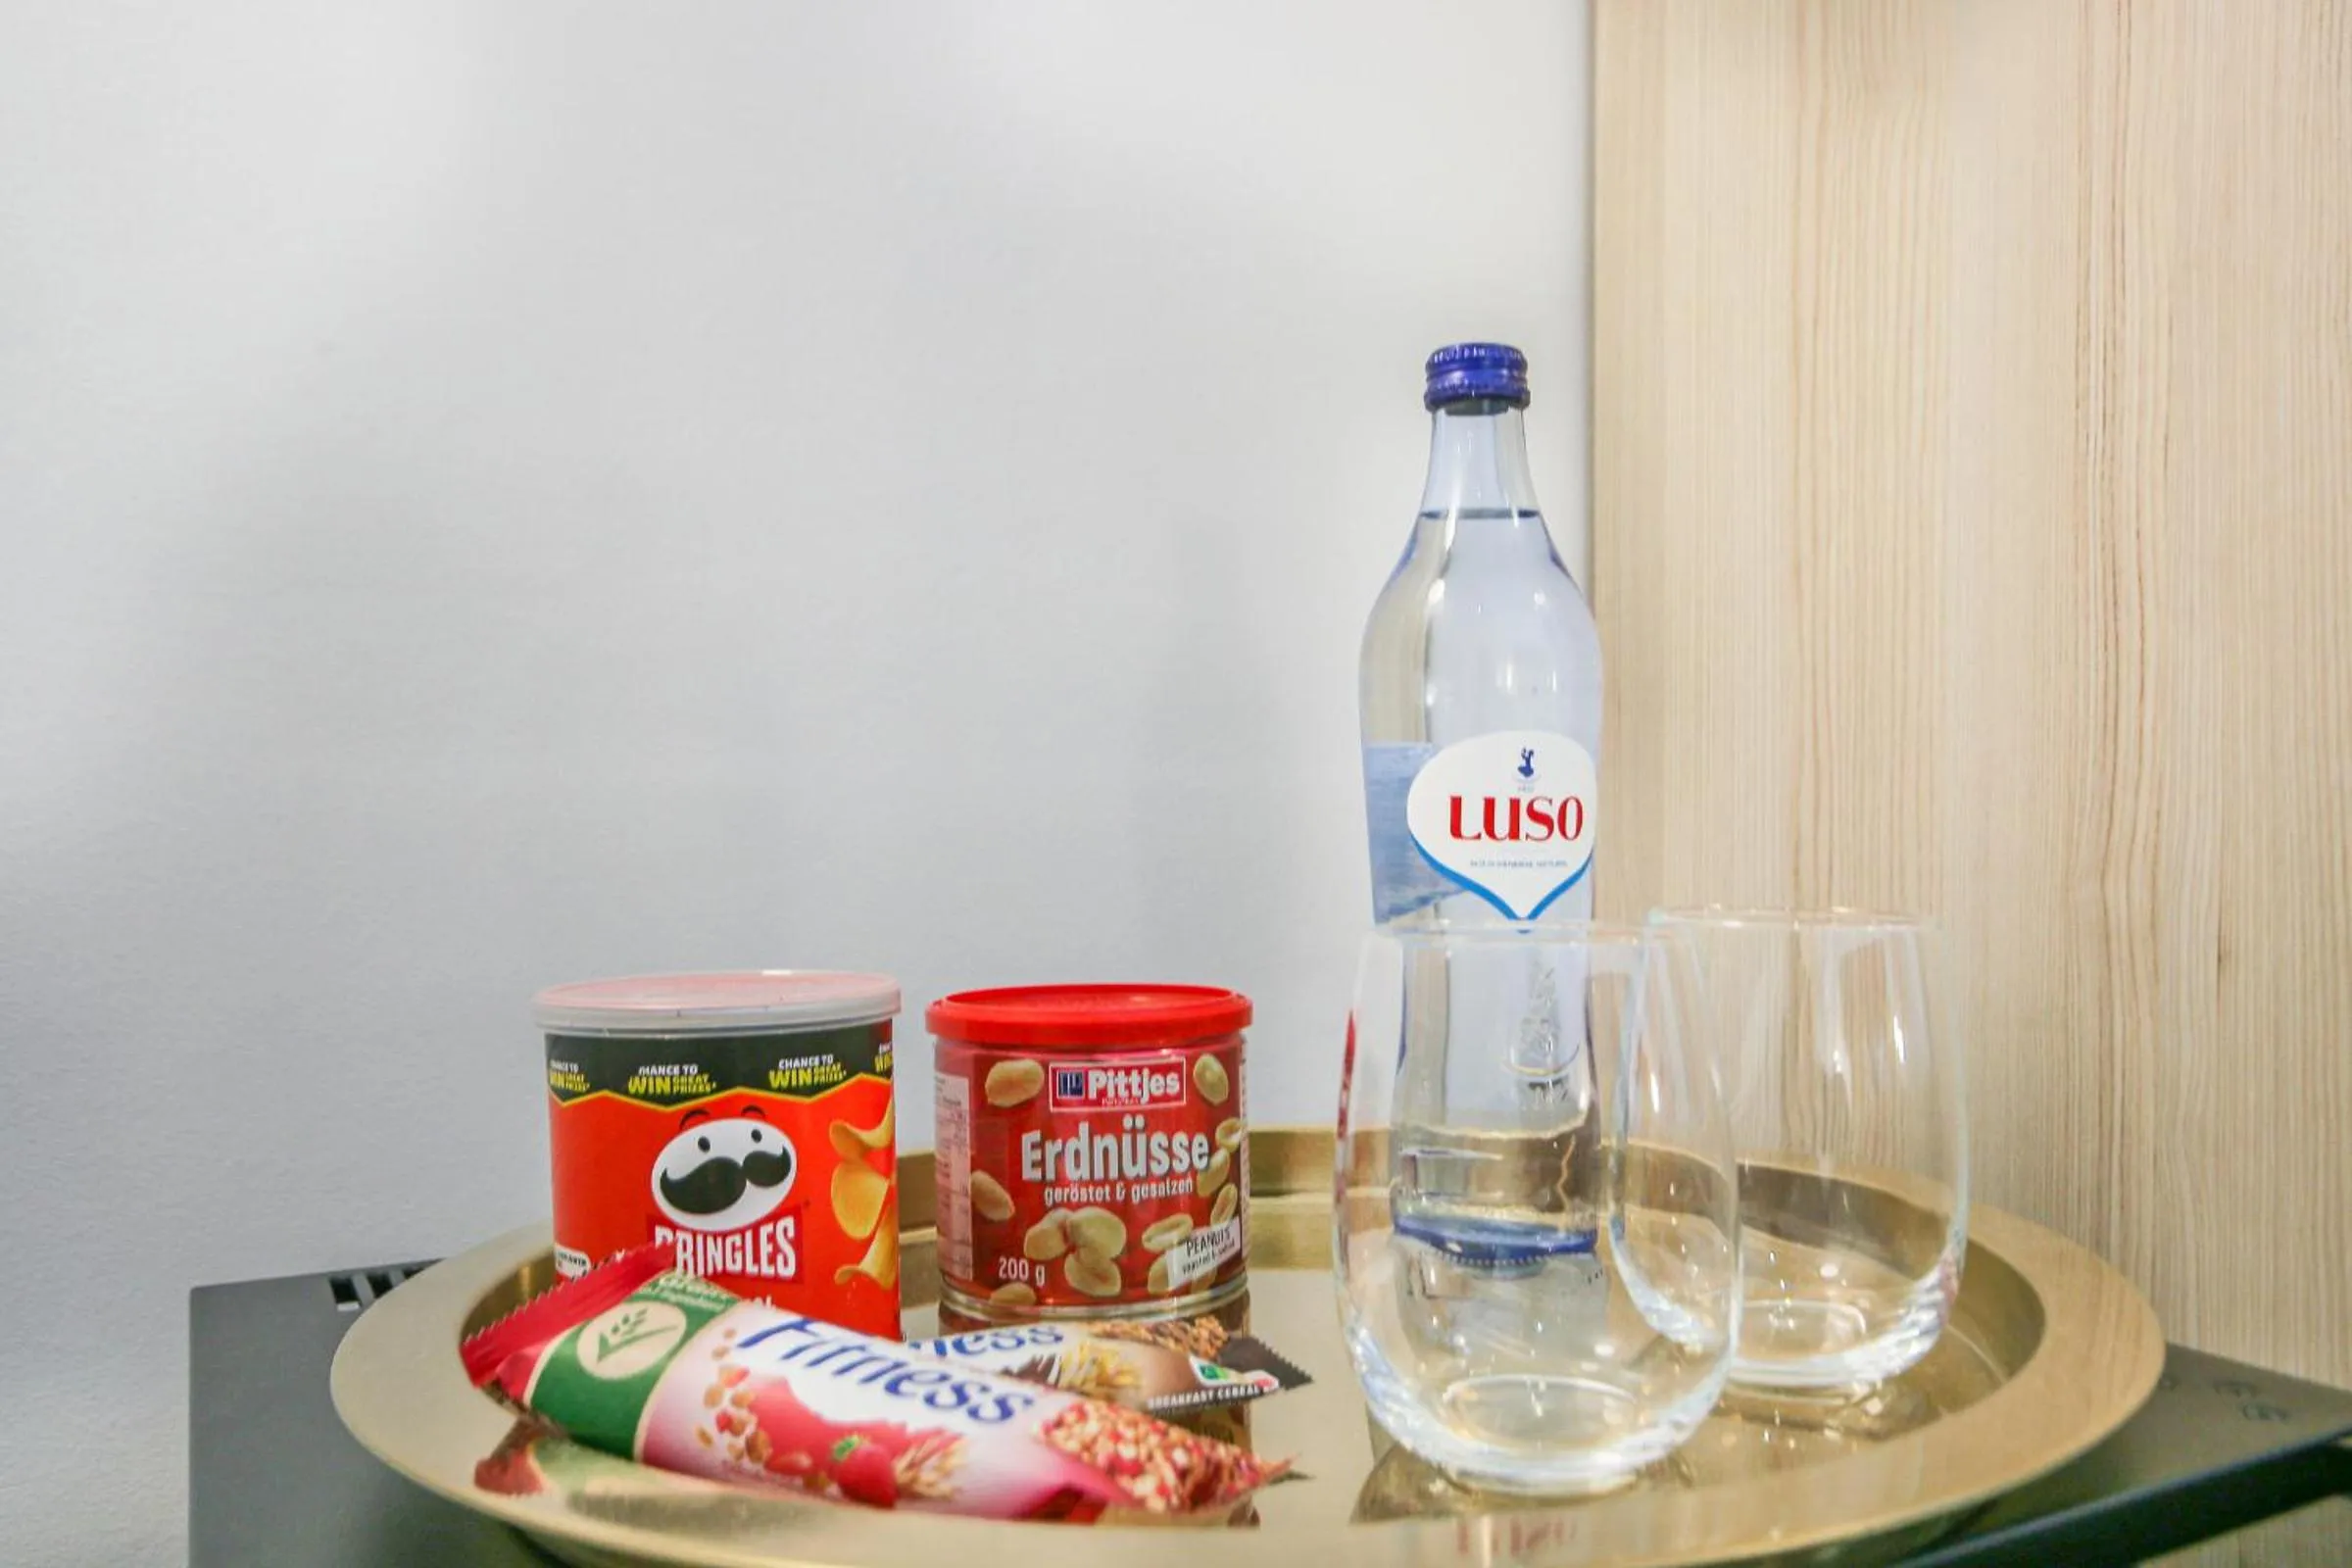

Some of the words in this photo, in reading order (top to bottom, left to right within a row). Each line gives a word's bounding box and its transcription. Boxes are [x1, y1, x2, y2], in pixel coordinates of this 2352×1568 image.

[1449, 795, 1584, 841] LUSO
[682, 1063, 699, 1075] TO
[778, 1055, 819, 1070] CHANCE
[821, 1054, 834, 1066] TO
[628, 1076, 671, 1096] WIN
[768, 1069, 812, 1091] WIN
[1088, 1067, 1181, 1105] Pittjes
[1022, 1113, 1209, 1181] Erdnüsse
[1045, 1182, 1111, 1206] geröstet
[1186, 1228, 1231, 1257] PEANUTS
[998, 1256, 1028, 1279] 200
[1036, 1264, 1046, 1285] g
[736, 1317, 1034, 1424] Fitness
[1148, 1392, 1214, 1409] BREAKFAST
